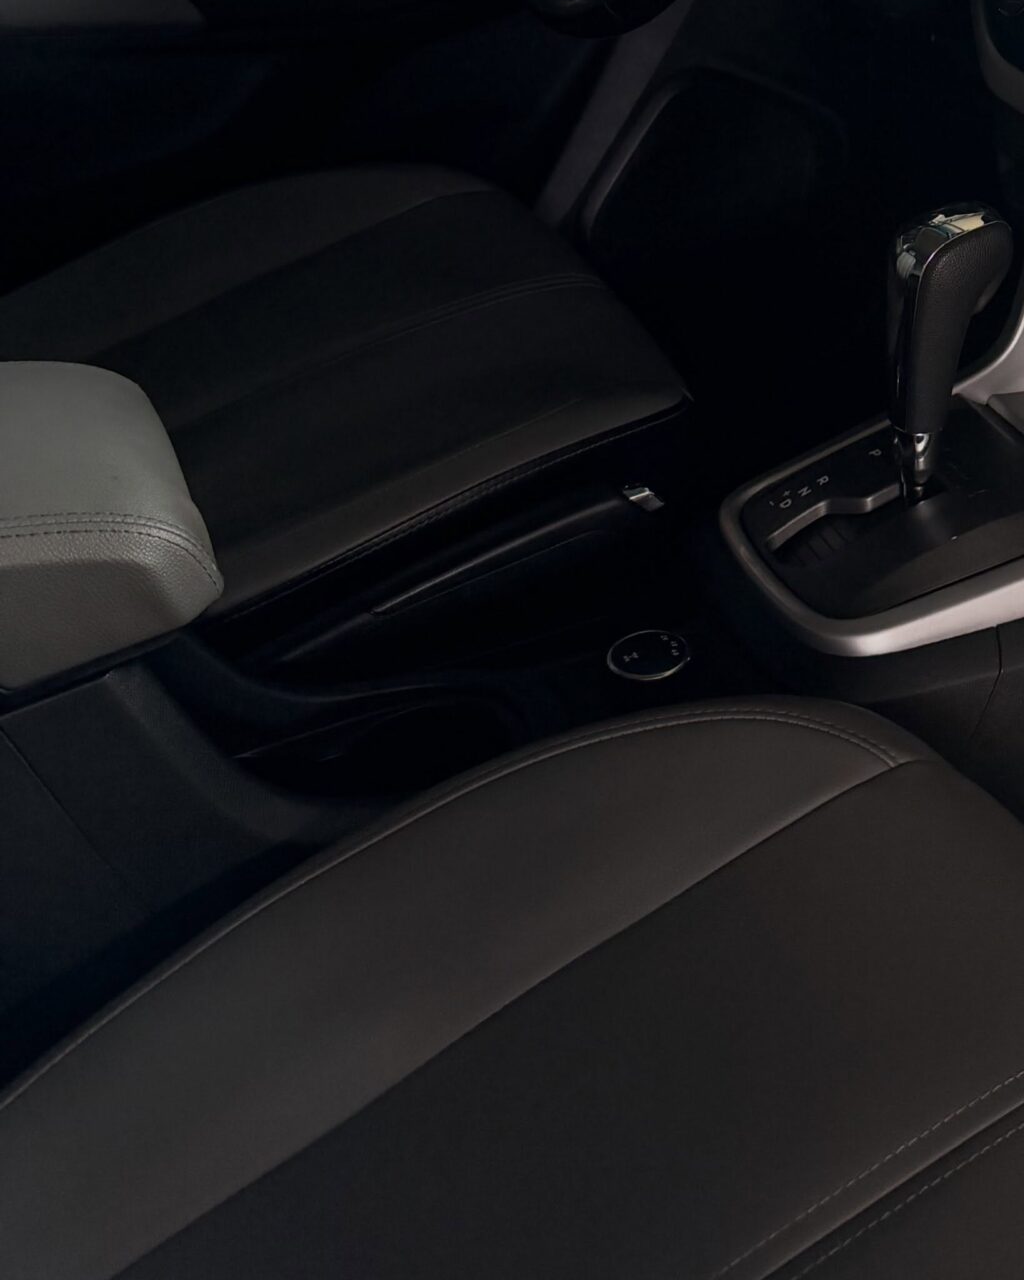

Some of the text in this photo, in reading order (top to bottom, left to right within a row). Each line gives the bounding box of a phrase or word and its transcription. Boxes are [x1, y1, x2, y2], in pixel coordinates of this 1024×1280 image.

[867, 448, 882, 456] P
[816, 475, 829, 486] R
[797, 486, 812, 497] N
[779, 498, 792, 509] D
